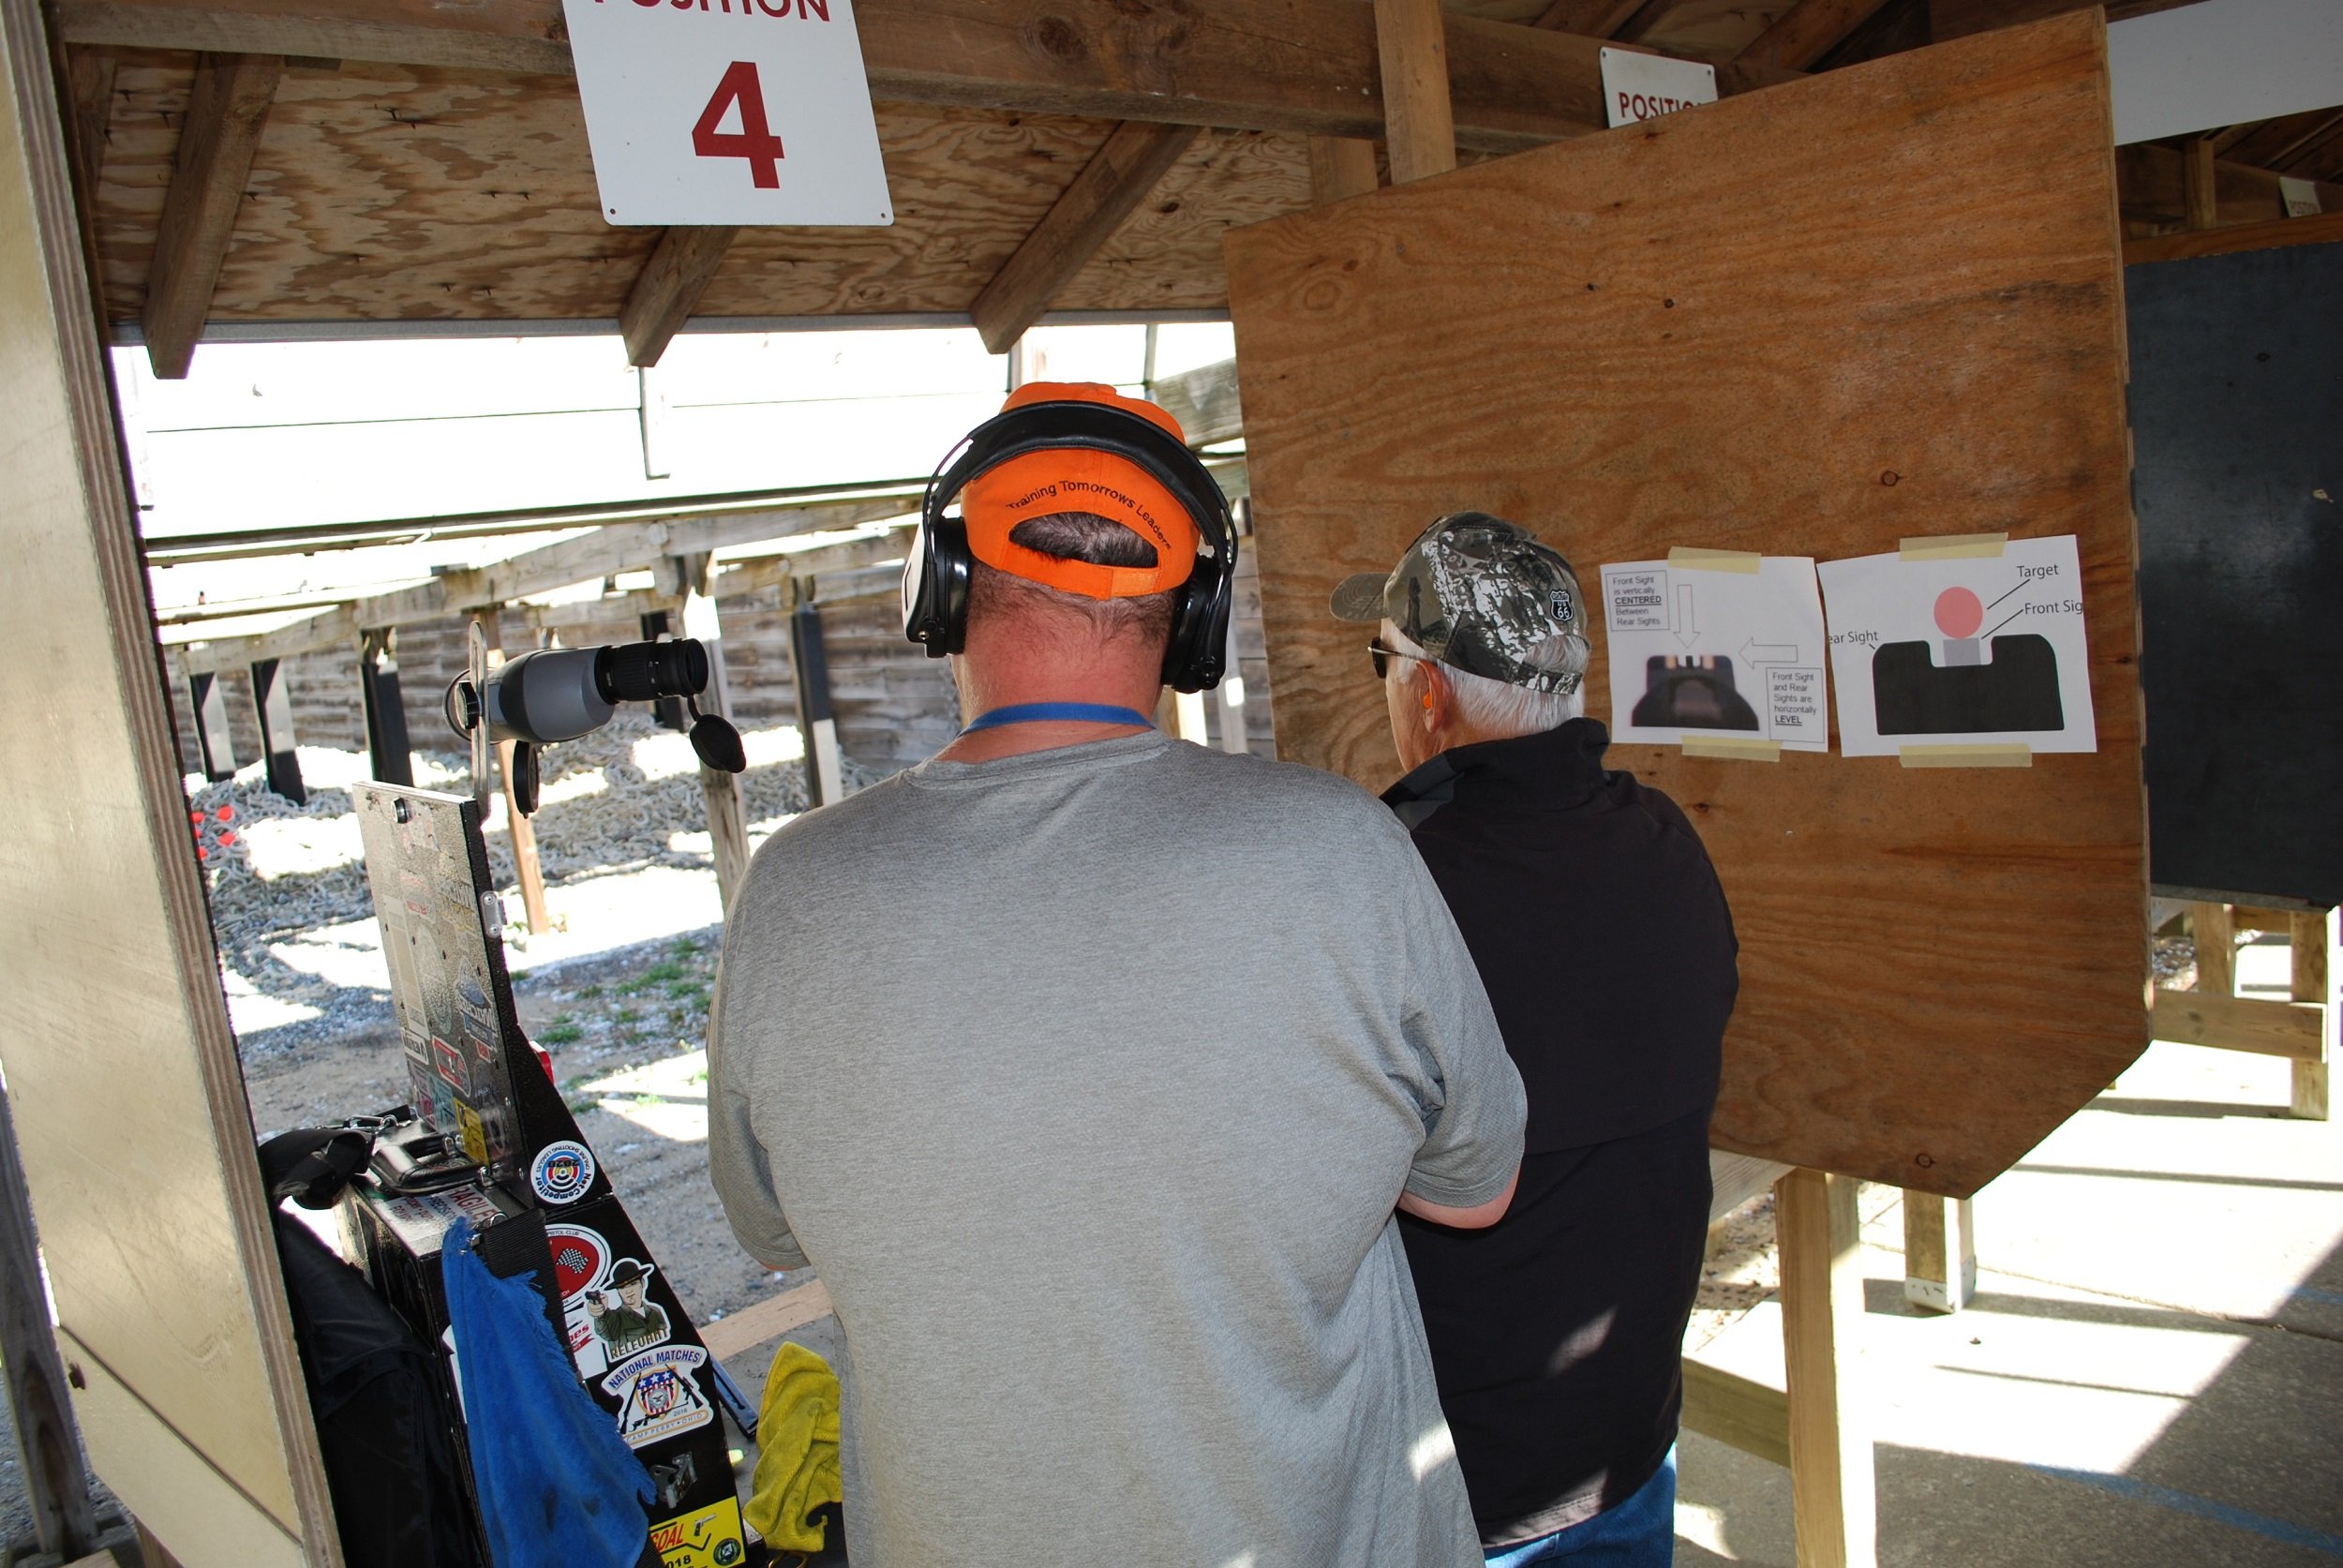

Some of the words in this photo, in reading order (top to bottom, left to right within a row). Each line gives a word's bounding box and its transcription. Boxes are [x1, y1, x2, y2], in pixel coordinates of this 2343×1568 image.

[1618, 91, 1704, 120] POSIT
[692, 61, 784, 189] 4
[1006, 484, 1057, 510] Training
[1059, 479, 1137, 509] Tomorrows
[1136, 504, 1172, 551] Leaders
[2016, 563, 2059, 580] Target
[1612, 576, 1633, 586] Front
[1634, 575, 1655, 586] Sight
[1622, 586, 1655, 595] vertically
[1615, 595, 1662, 605] CENTERED
[1557, 606, 1570, 619] 66
[1616, 607, 1649, 616] Between
[2024, 602, 2060, 615] Front
[2063, 599, 2083, 615] Sig
[1617, 618, 1635, 626] Rear
[1636, 617, 1661, 627] Sights
[1829, 634, 1844, 644] ear
[1847, 630, 1878, 645] Sight
[1772, 672, 1793, 680] Front
[1795, 672, 1814, 682] Sight
[1773, 683, 1787, 692] and
[1789, 683, 1807, 692] Rear
[1773, 694, 1798, 704] Sights
[1774, 705, 1816, 716] horizontally
[1775, 714, 1802, 724] LEVEL
[607, 1355, 654, 1389] NATIONAL
[656, 1349, 702, 1364] MATCHES
[650, 1421, 676, 1433] PERRY
[681, 1413, 703, 1425] OHIO
[665, 1554, 692, 1568] 018
